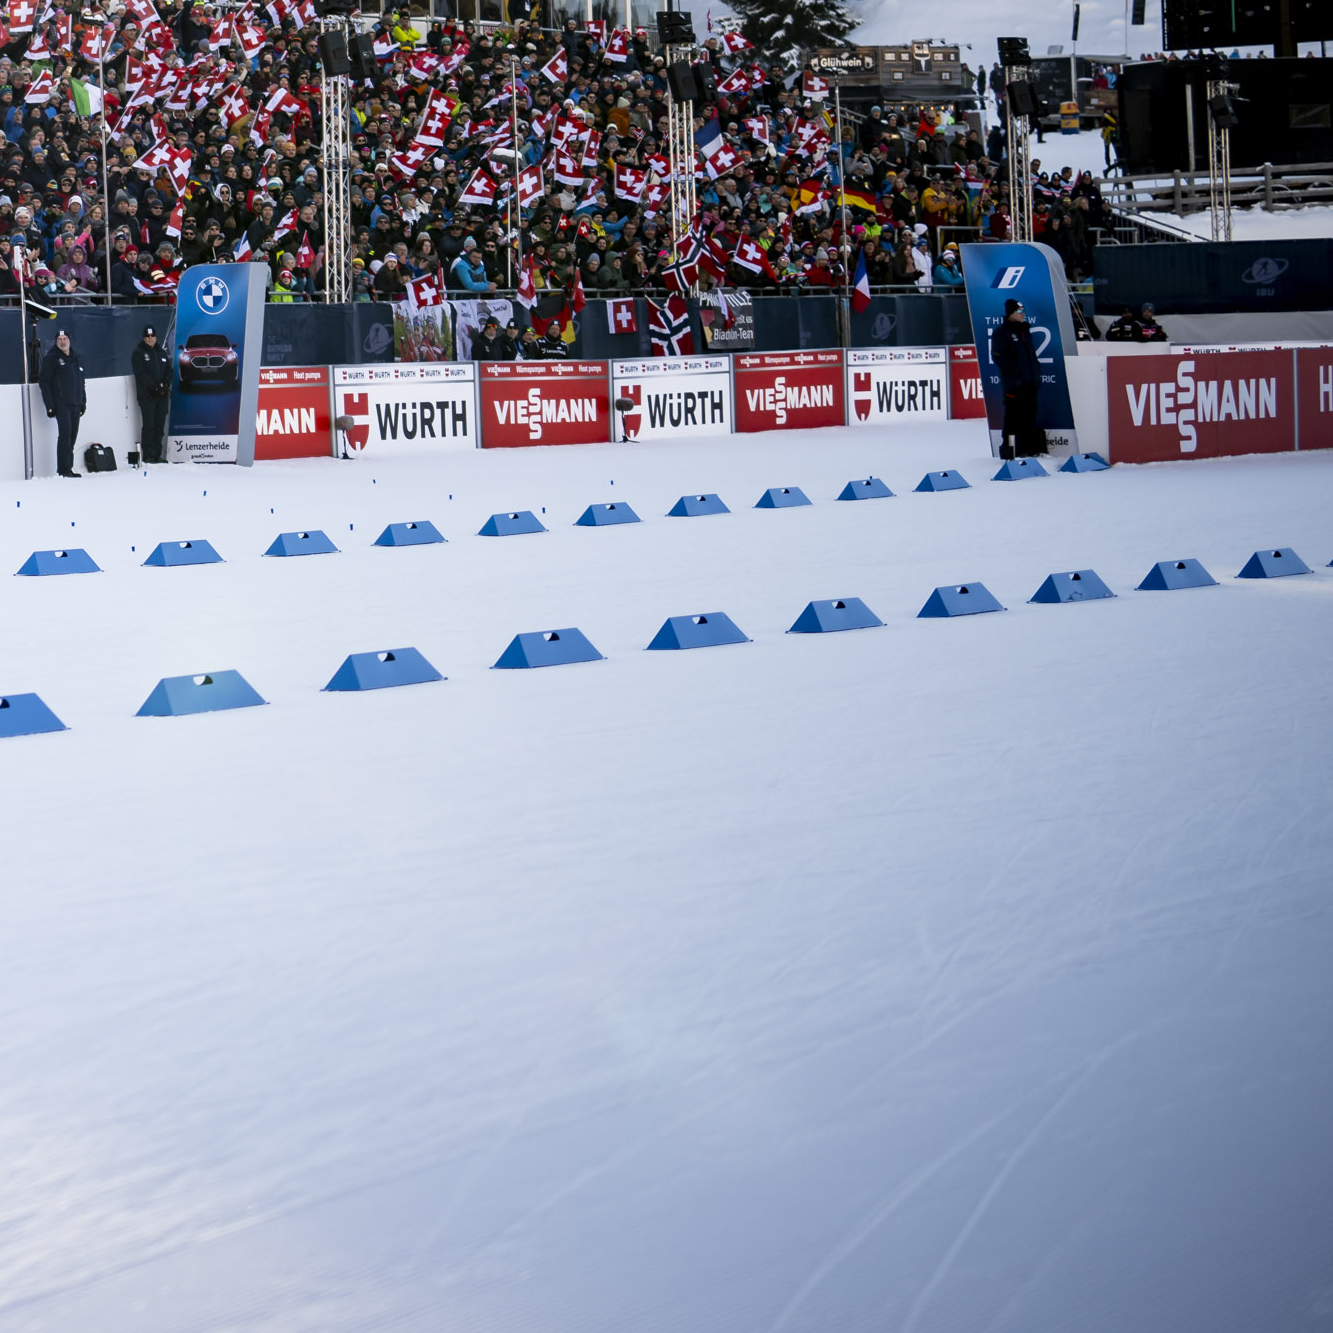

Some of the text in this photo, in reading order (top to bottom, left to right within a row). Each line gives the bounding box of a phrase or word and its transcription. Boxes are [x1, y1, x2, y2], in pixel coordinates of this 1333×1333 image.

[820, 57, 862, 67] Glühwein
[1256, 287, 1275, 297] IBU
[261, 370, 321, 383] VIESSMANN Heat pumps
[348, 372, 365, 380] WÜRTH
[374, 371, 390, 379] WÜRTH
[400, 370, 416, 378] WÜRTH
[450, 369, 466, 377] WÜRTH
[647, 390, 724, 429] WÜRTH
[745, 376, 834, 425] VIESSMANN
[876, 379, 941, 413] WÜRTH
[1125, 360, 1276, 453] VIESSMANN
[376, 400, 468, 441] WÜRTH
[493, 387, 597, 440] VIESSMANN
[185, 440, 230, 451] Lenzerheide
